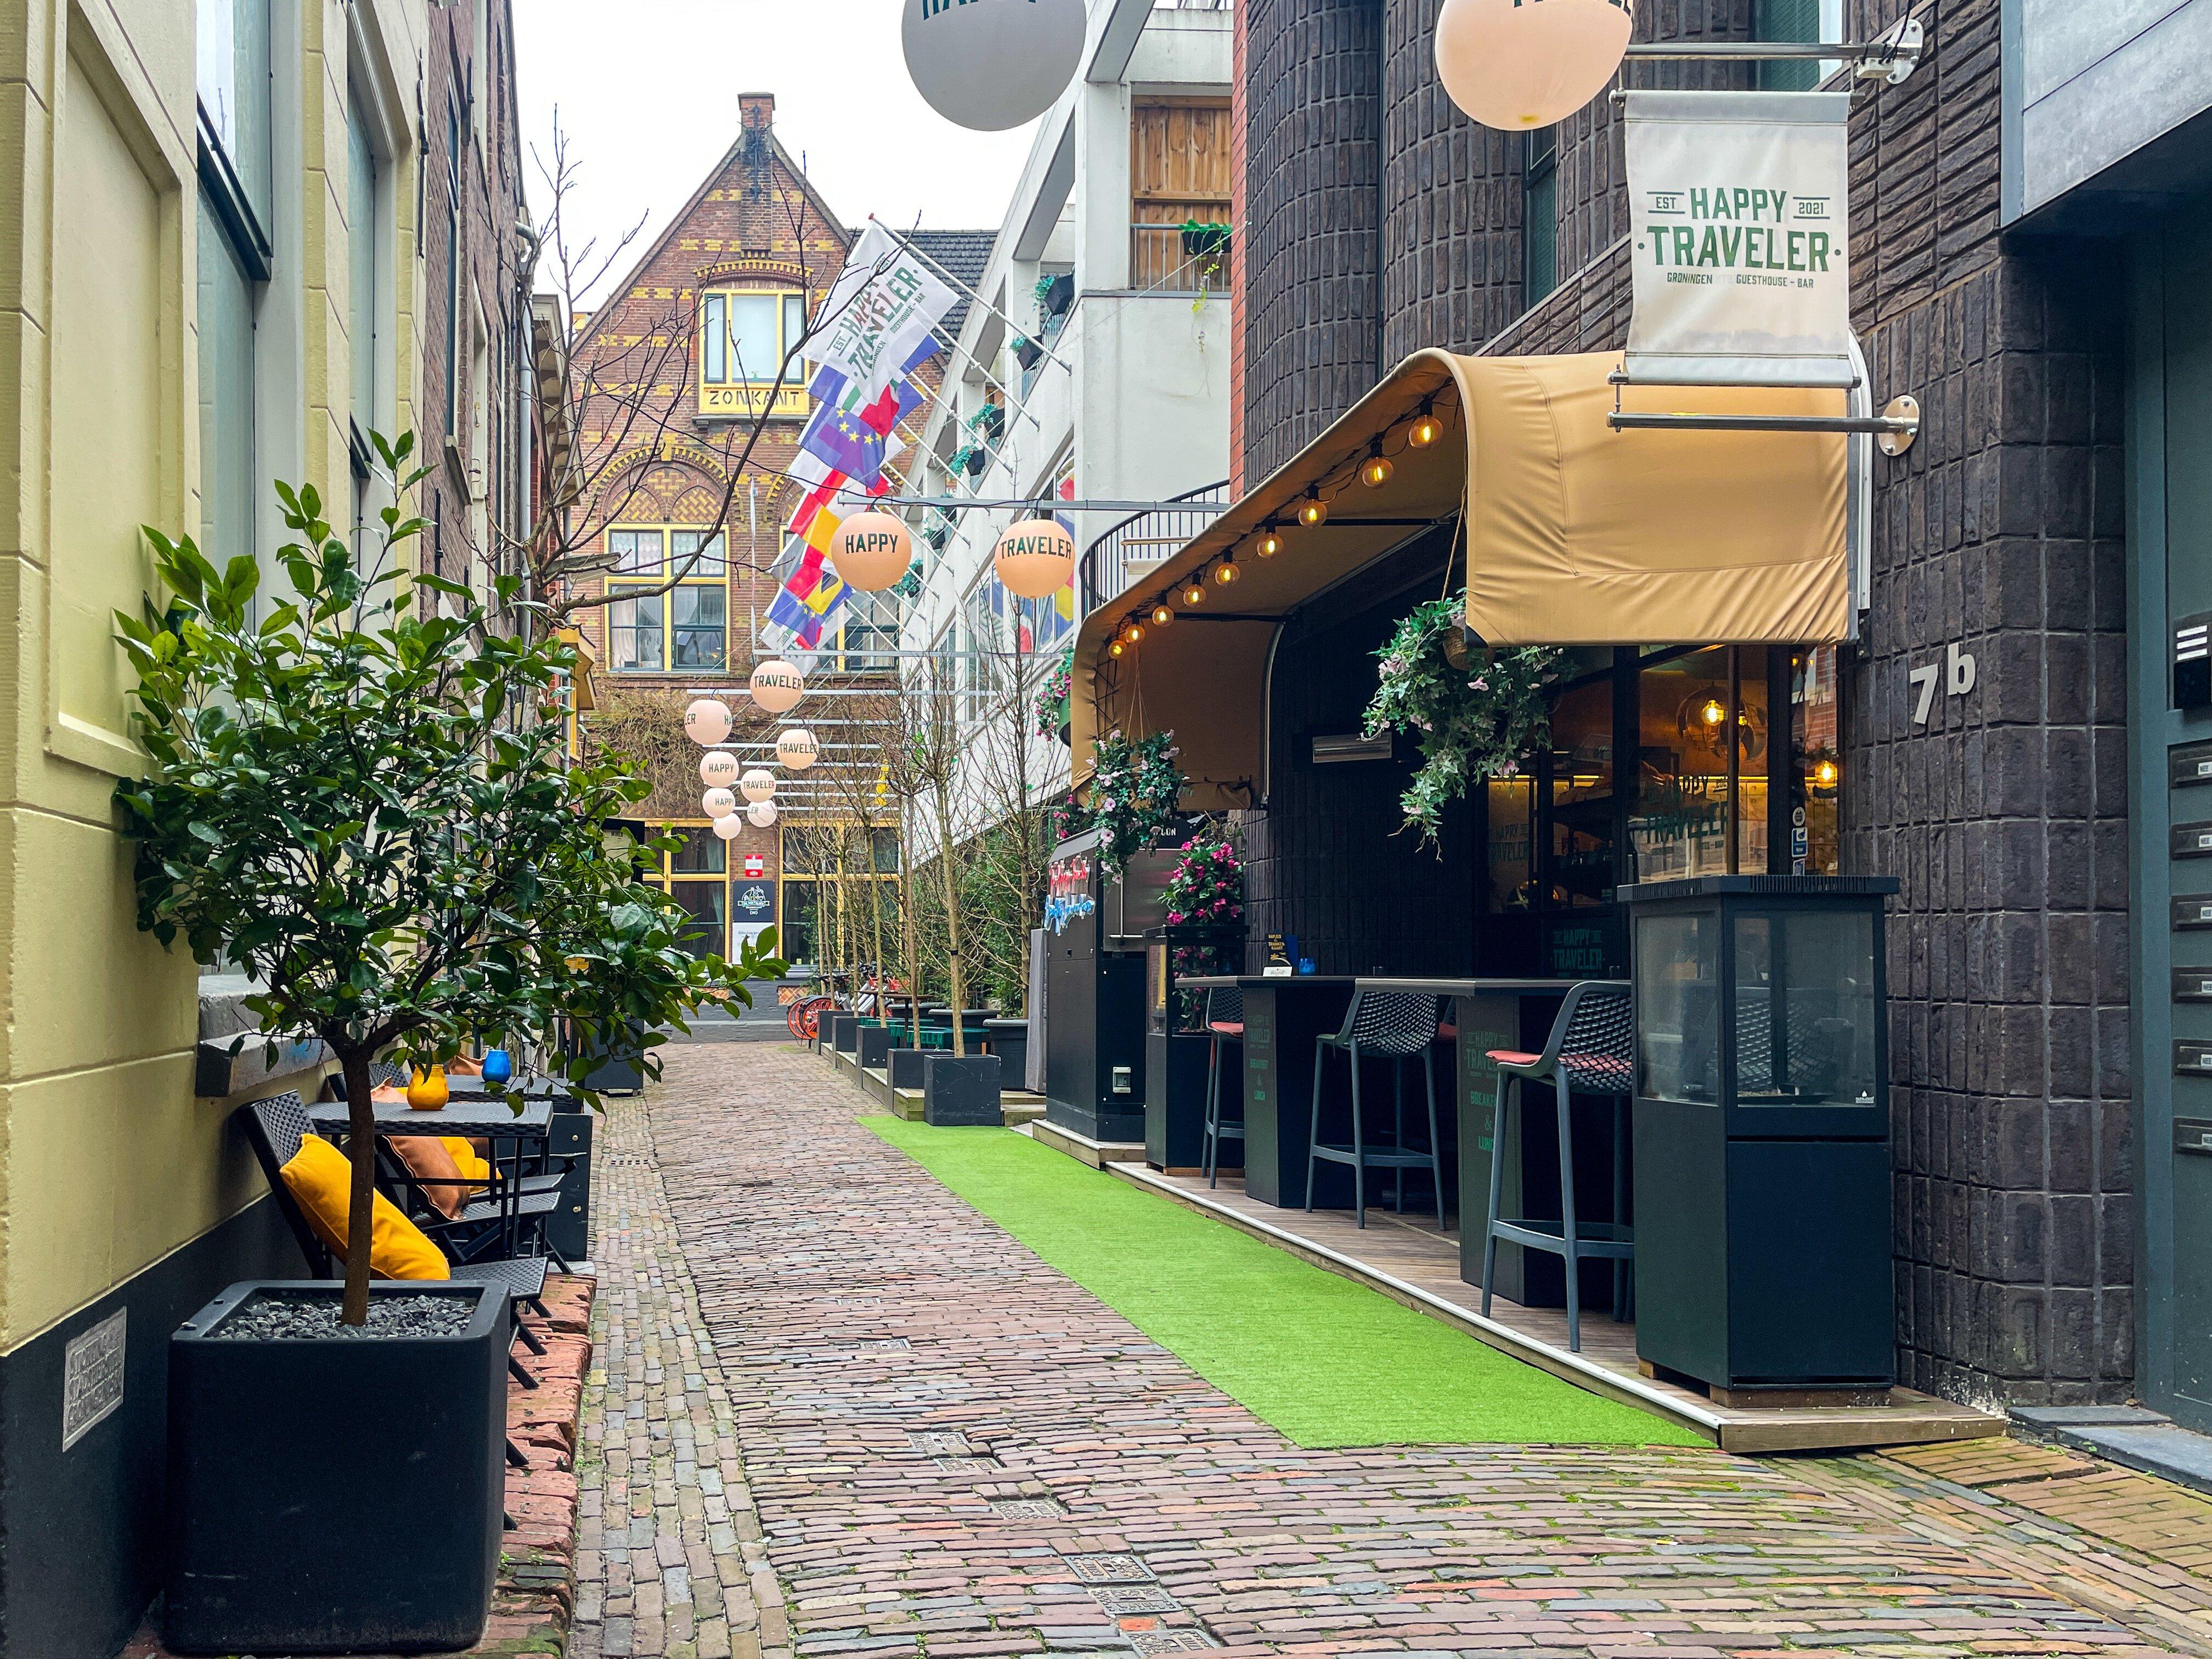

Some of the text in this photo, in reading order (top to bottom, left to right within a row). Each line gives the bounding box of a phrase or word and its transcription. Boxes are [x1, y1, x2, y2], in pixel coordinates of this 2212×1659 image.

[1656, 188, 1824, 223] EST HAPPY 2021
[1646, 225, 1830, 272] TRAVELER
[1667, 272, 1713, 284] GRONINGEN
[1736, 274, 1788, 287] GUESTHOUSE
[1797, 276, 1814, 289] BAR
[914, 292, 926, 304] BAR
[833, 336, 847, 351] EST
[845, 532, 899, 554] HAPPY
[1000, 535, 1073, 560] TRAVELER
[754, 674, 802, 691] TRAVELER
[709, 763, 734, 773] HAPPY
